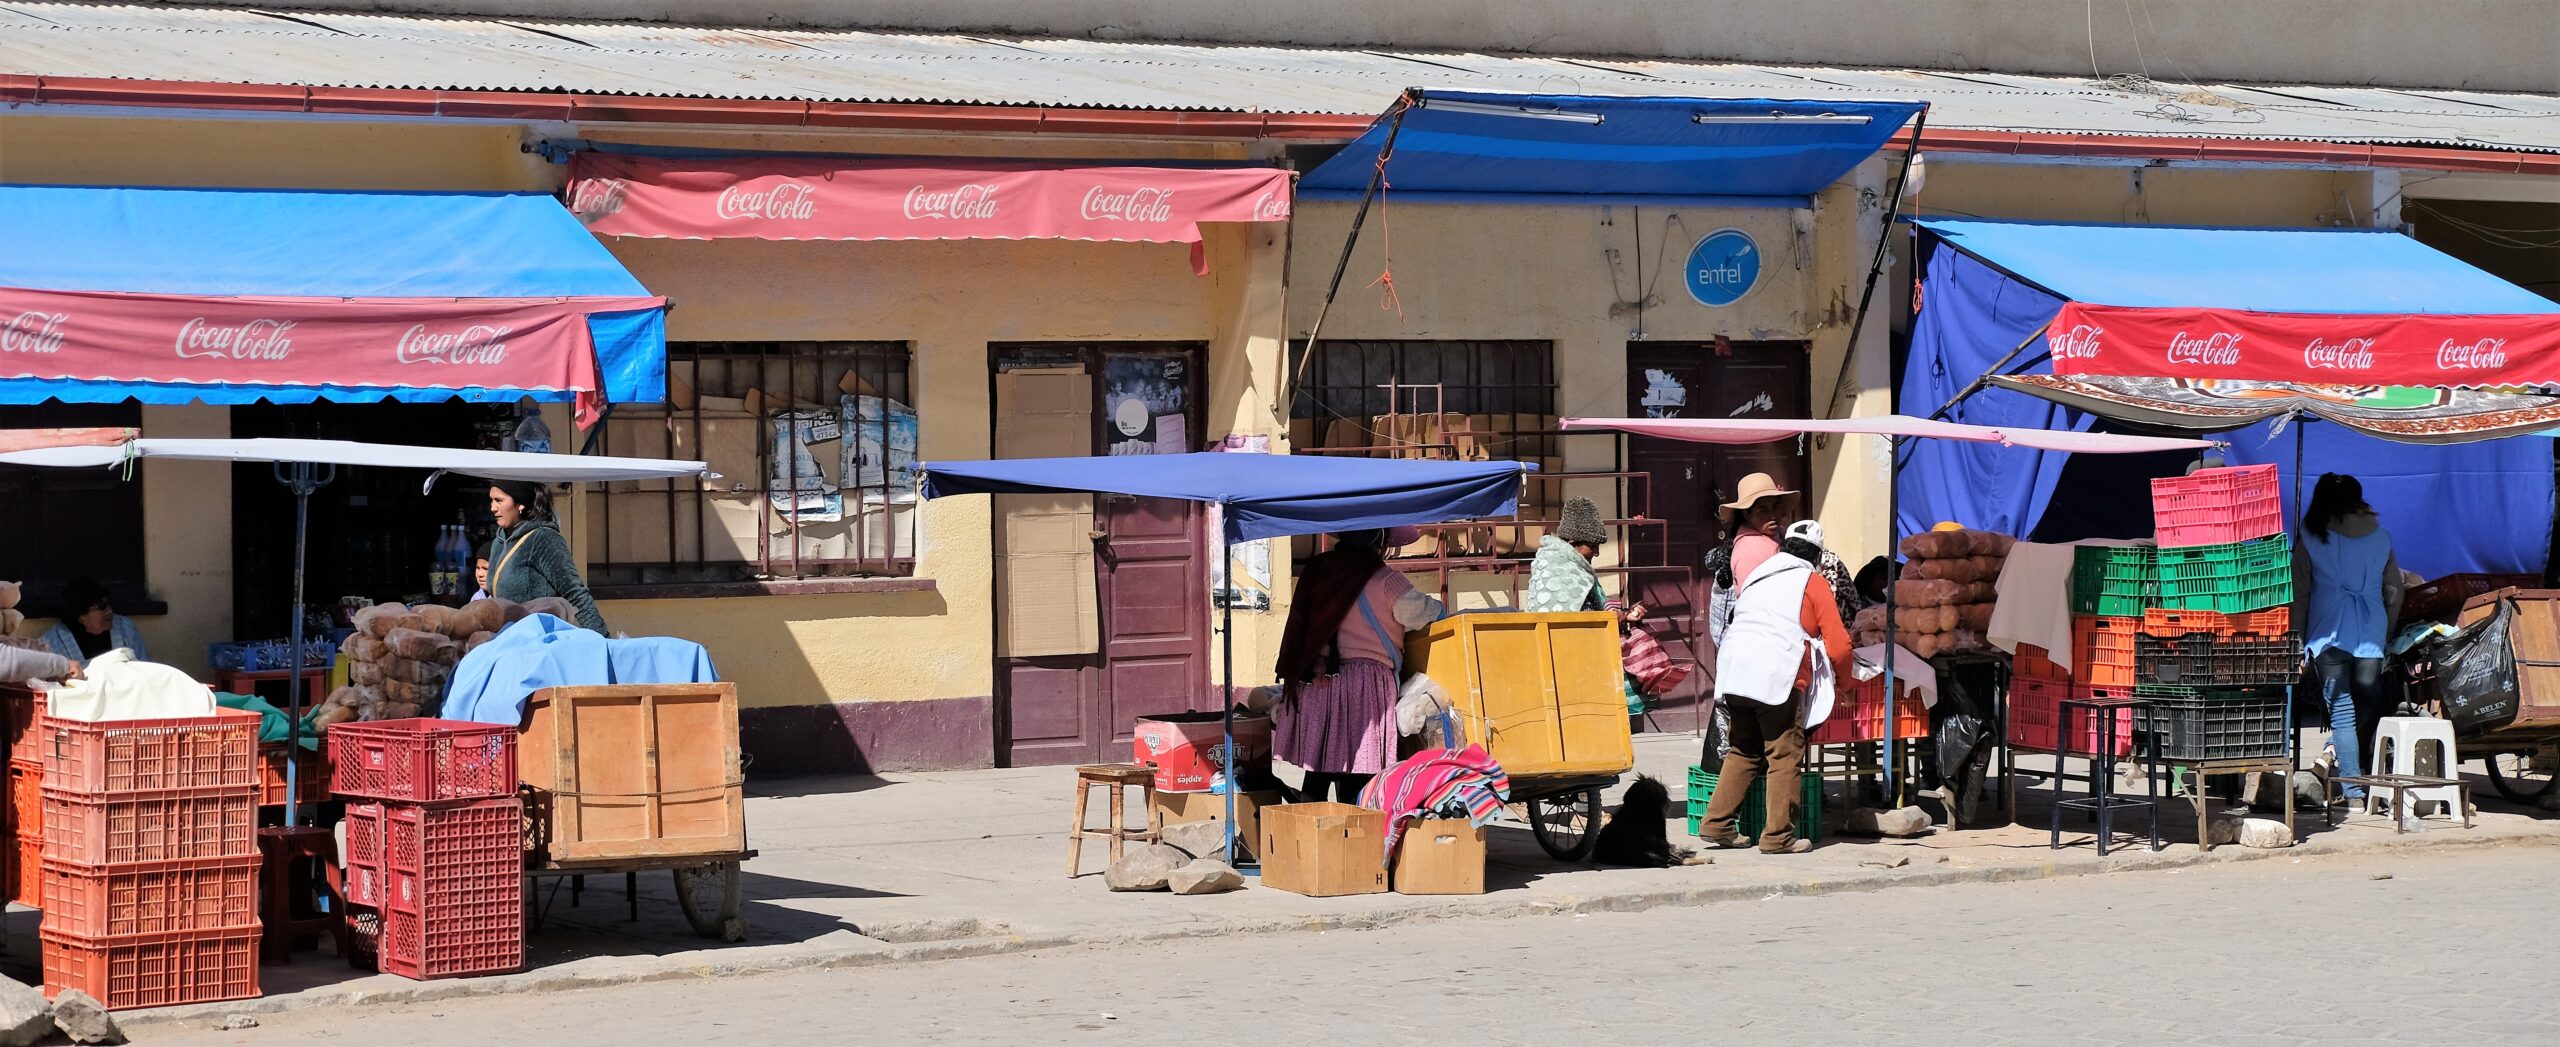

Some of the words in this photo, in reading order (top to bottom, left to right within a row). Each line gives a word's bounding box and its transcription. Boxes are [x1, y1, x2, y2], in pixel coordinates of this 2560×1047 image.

[716, 184, 817, 220] Coca-Cola
[903, 183, 1000, 220] Coca-Cola
[1080, 185, 1175, 223] Coca-Cola
[1699, 263, 1741, 284] entel
[175, 317, 297, 360] Coca-Cola
[396, 322, 515, 366] Coca-Cola
[2167, 330, 2244, 366] Coca-Cola
[2304, 337, 2376, 370] Coca-Cola
[2437, 337, 2508, 370] Coca-Cola
[1177, 774, 1203, 785] apples
[1376, 873, 1383, 885] H
